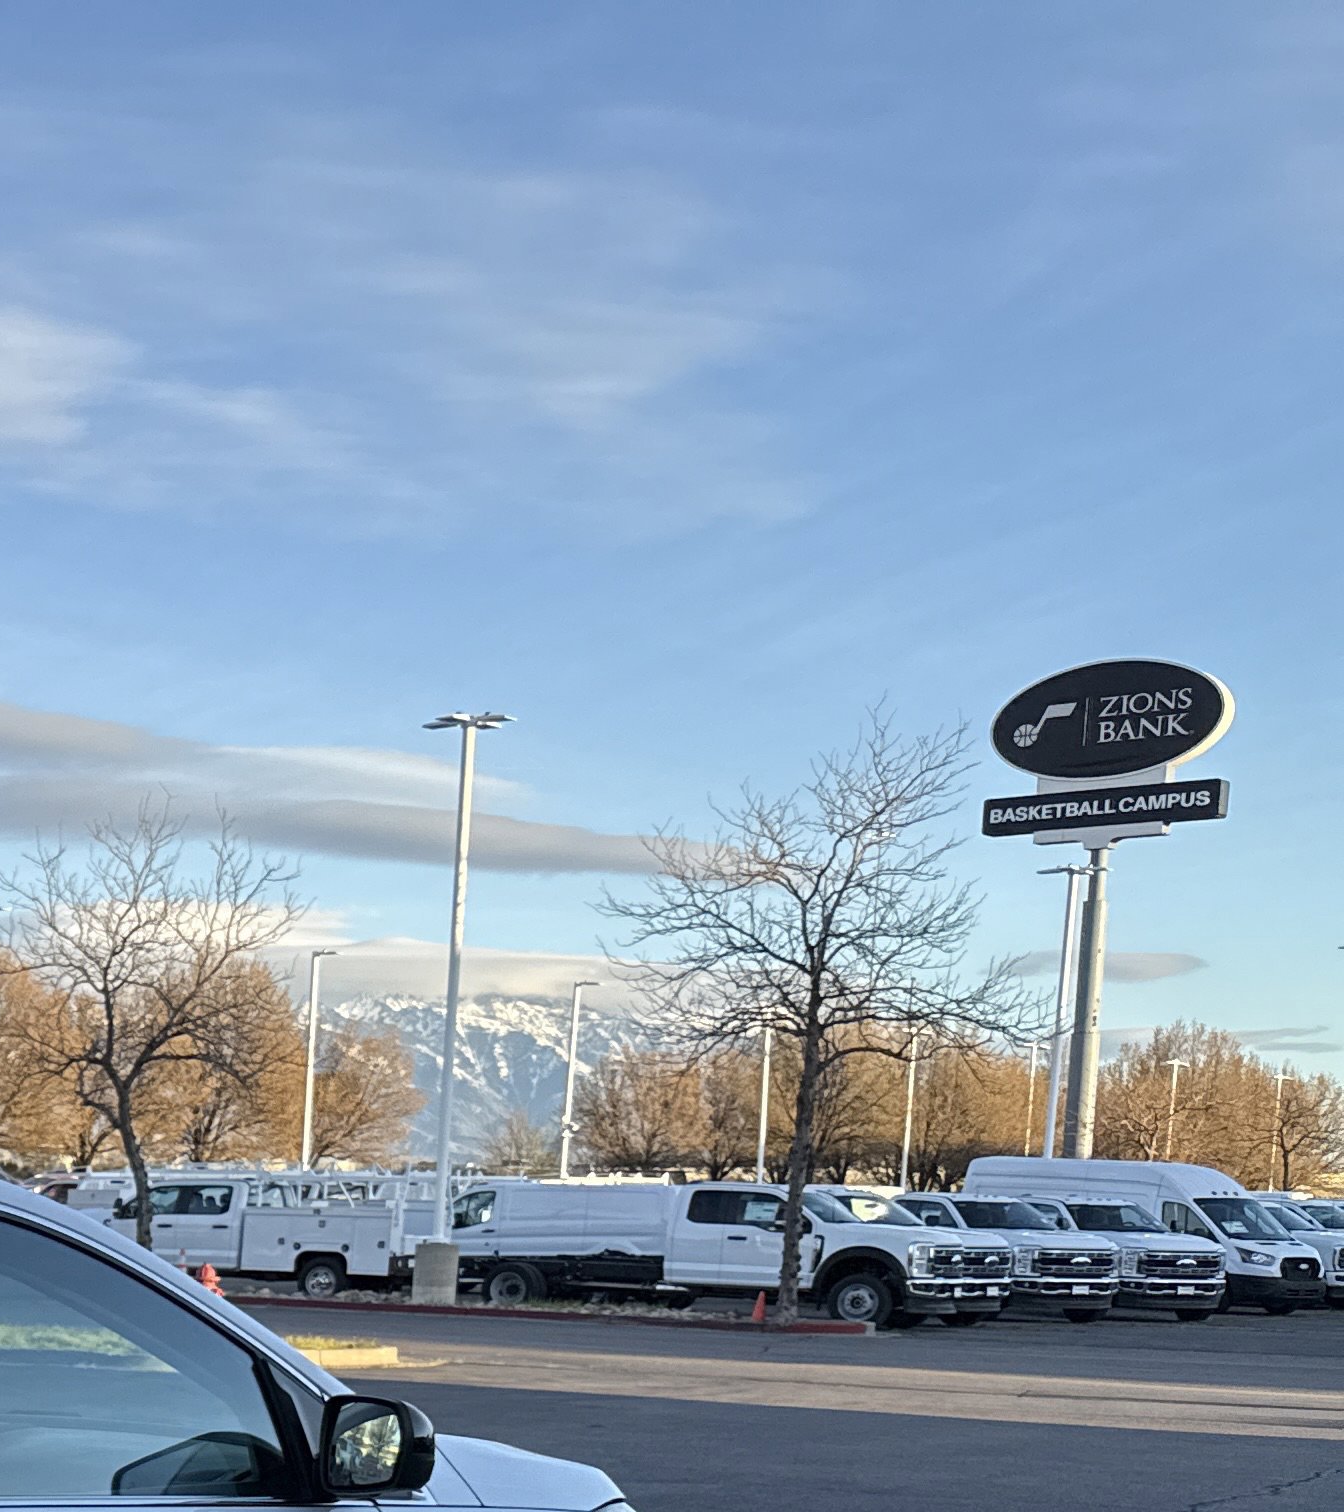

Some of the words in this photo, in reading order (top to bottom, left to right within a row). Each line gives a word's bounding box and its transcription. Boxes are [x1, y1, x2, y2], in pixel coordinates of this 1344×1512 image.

[1098, 687, 1193, 718] ZIONS
[1096, 712, 1190, 744] BANK
[989, 800, 1116, 825] BASKETBALL
[1118, 790, 1211, 813] CAMPUS
